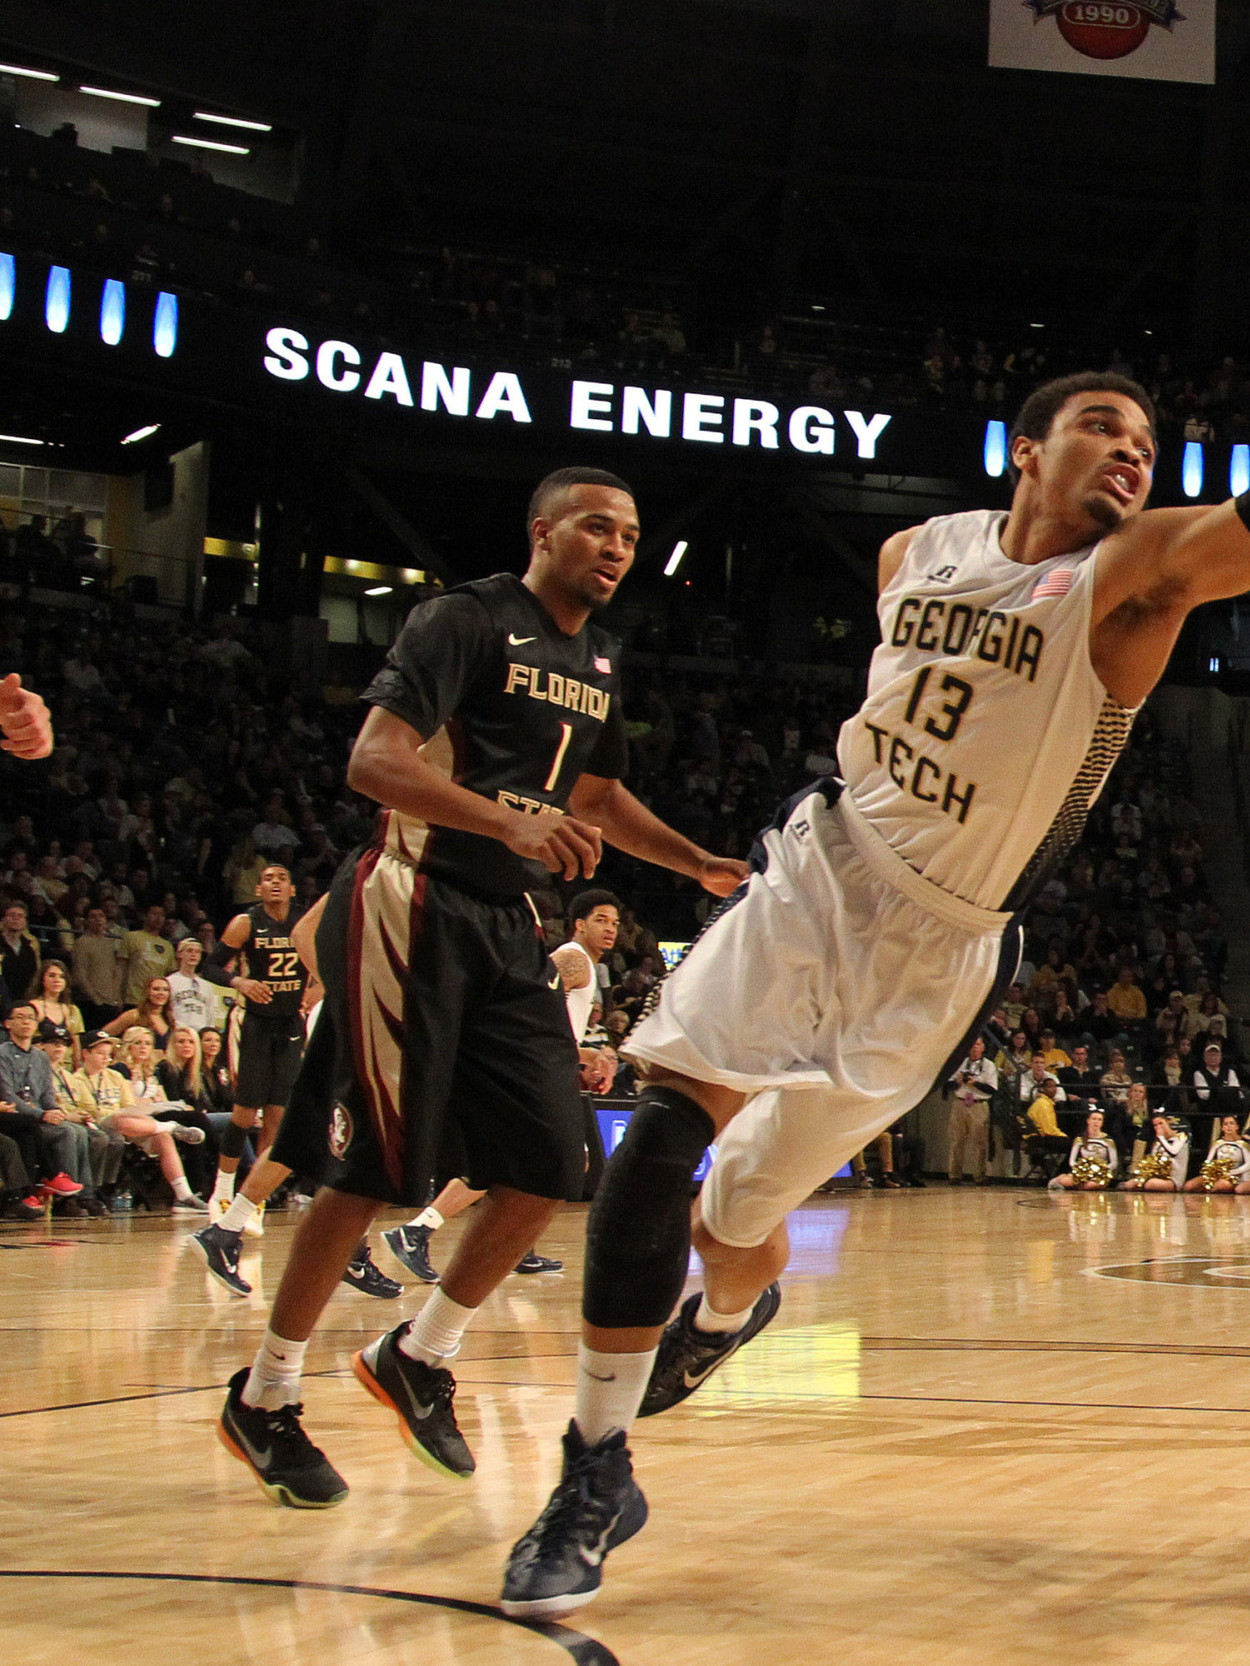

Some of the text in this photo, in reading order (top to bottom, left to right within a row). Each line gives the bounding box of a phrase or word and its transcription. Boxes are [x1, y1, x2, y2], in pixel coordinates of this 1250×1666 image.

[1074, 4, 1129, 24] 1990
[264, 327, 892, 460] SCANA ENERGY
[904, 666, 973, 742] 13
[544, 722, 573, 793] 1
[864, 721, 976, 825] TECH
[254, 936, 296, 949] FLOR
[268, 952, 300, 977] 22
[261, 979, 302, 993] TATE
